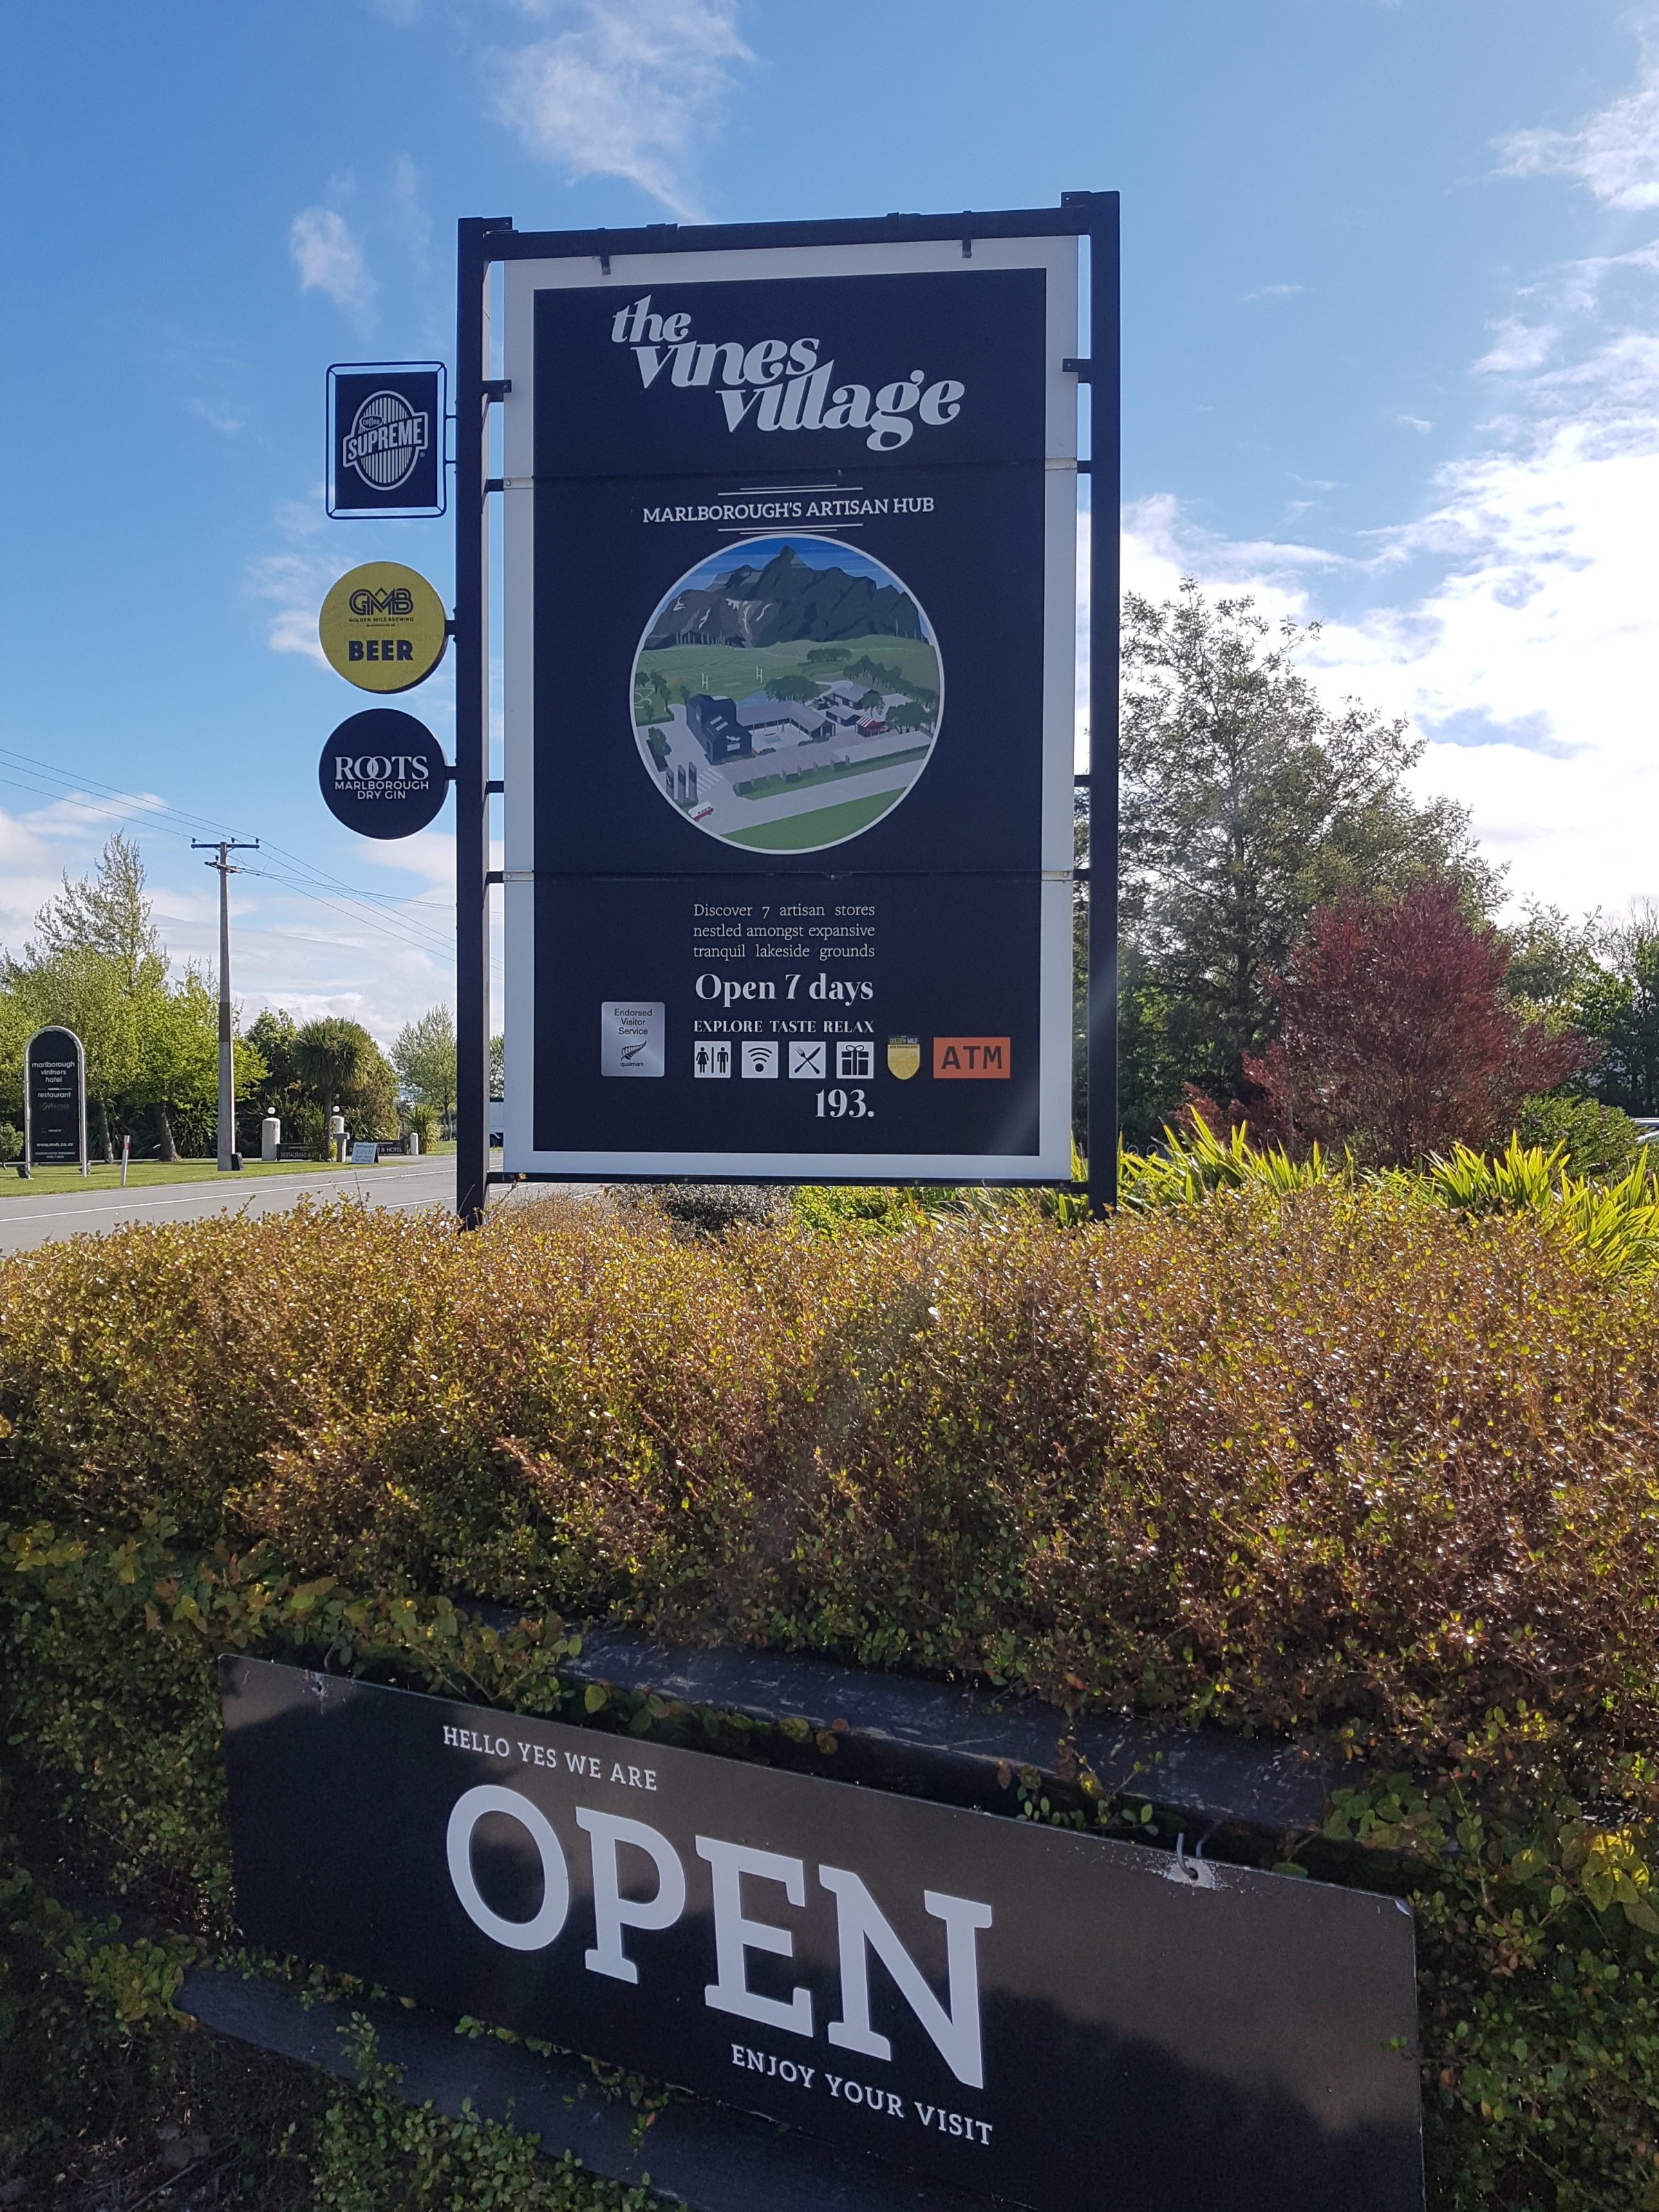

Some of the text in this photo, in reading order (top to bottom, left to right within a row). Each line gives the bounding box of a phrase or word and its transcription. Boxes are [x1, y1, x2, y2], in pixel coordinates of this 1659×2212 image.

[612, 294, 692, 344] the
[630, 337, 820, 389] vines
[715, 359, 966, 451] village
[362, 417, 380, 427] coffee
[348, 418, 422, 460] SUPREME
[643, 497, 935, 523] MARLBOROUGH'S ARTISAN HUB
[348, 587, 414, 615] GMB
[348, 639, 414, 662] BEER
[335, 756, 429, 780] ROOTS
[335, 781, 429, 790] MARLBOROUGH
[357, 791, 406, 800] DRY GIN
[693, 903, 875, 919] Discover 7 artisan stores
[693, 924, 875, 941] nestled amongst expansive
[693, 944, 875, 961] tranquil lakeside grounds
[695, 973, 874, 1008] Open 7 days
[615, 1009, 653, 1017] Endorsed
[618, 1027, 648, 1035] Service
[693, 1020, 874, 1033] EXPLORE TASTE RELAX
[941, 1045, 1002, 1070] ATM
[815, 1089, 874, 1118] 193.
[442, 1725, 657, 1792] HELLO YES WE ARE
[446, 1783, 993, 2090] OPEN
[730, 2043, 993, 2146] ENJOY YOUR VISIT
